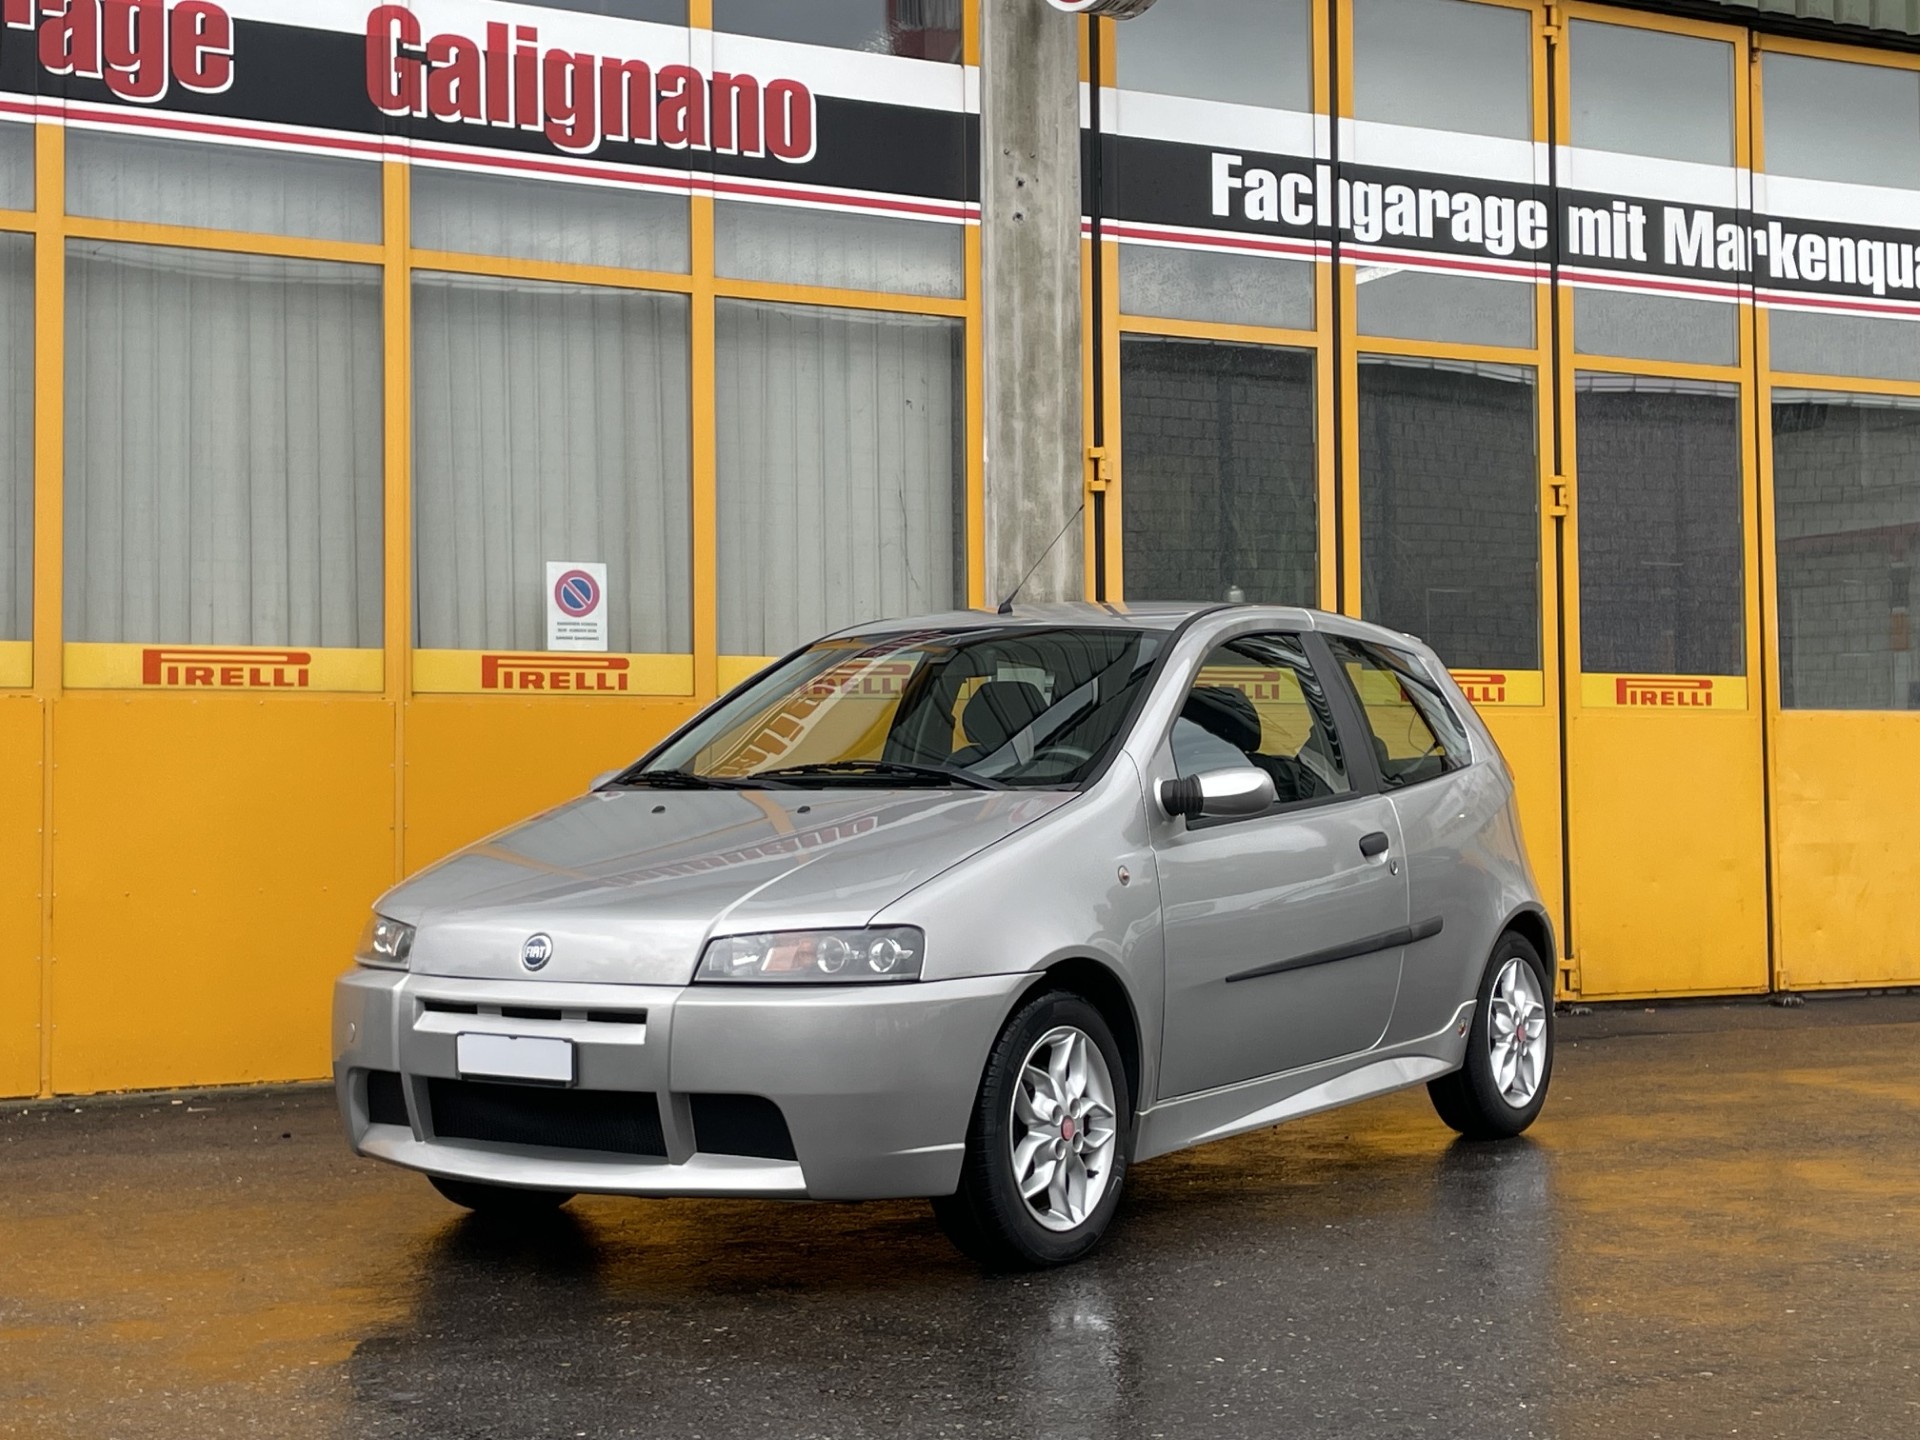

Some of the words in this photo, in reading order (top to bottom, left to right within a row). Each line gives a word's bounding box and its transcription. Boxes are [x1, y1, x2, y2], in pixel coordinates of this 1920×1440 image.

[366, 5, 817, 163] Galignano
[1211, 152, 1548, 256] Fachgarage
[1568, 200, 1647, 262] mit
[1663, 206, 1920, 295] Markenqu
[143, 649, 311, 687] PIRELLI
[482, 655, 630, 691] PIRELLI
[1616, 678, 1713, 706] PIRELLI
